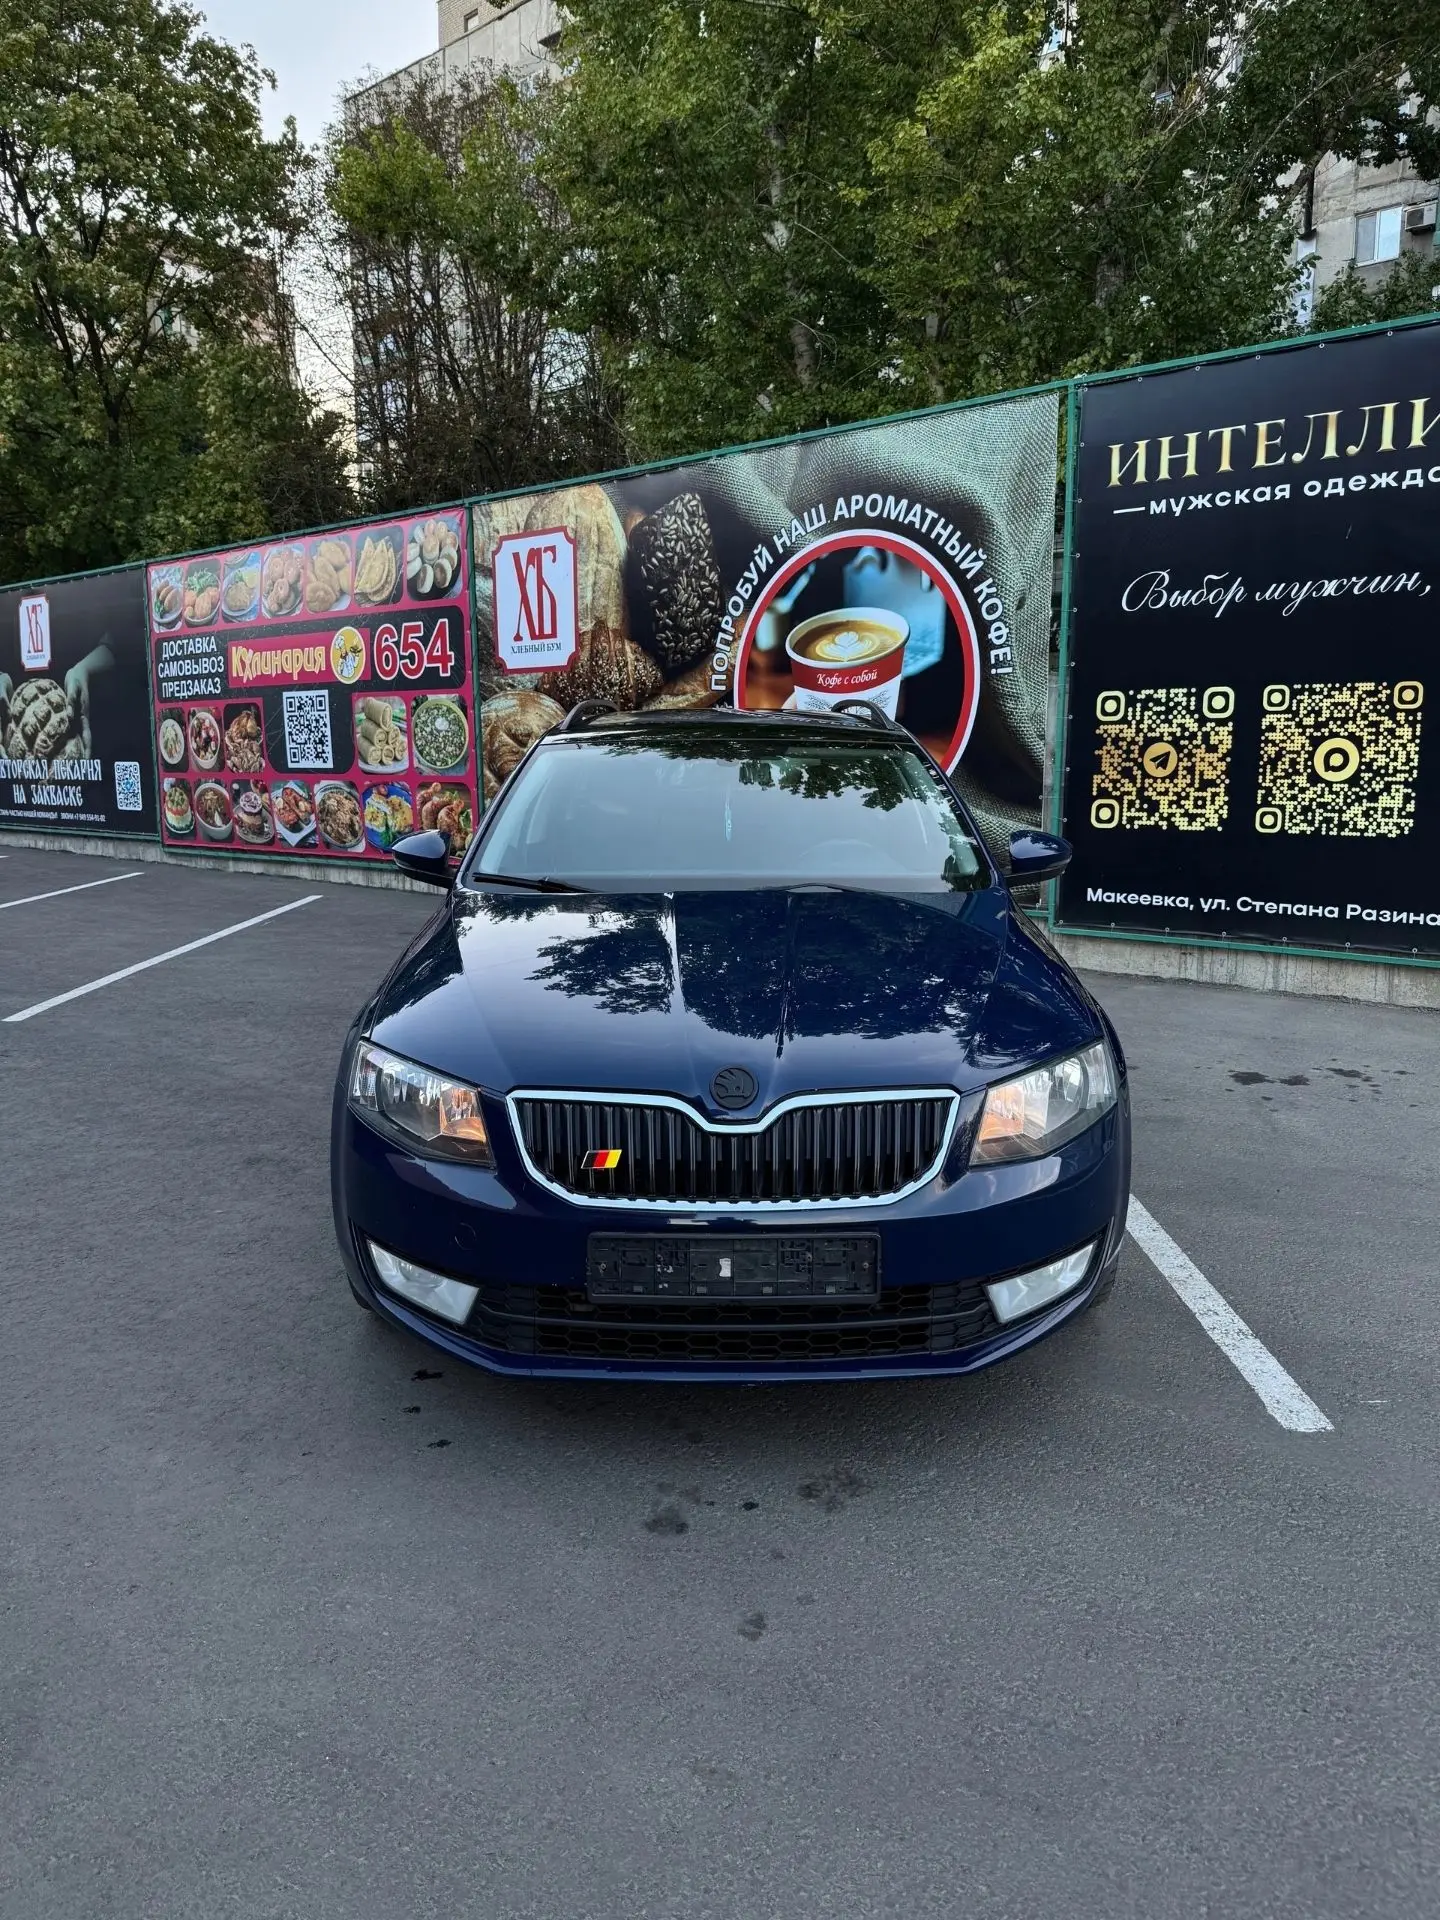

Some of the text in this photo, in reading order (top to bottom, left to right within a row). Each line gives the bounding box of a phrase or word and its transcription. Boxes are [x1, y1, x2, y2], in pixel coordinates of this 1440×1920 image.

[1150, 483, 1291, 517] мужская
[711, 493, 1013, 691] ПОПРОБУЙ НАШ АРОМАТНЫЙ КОФЕ!
[1121, 568, 1432, 618] Выбор мужчин,
[162, 636, 217, 661] ДОСТАВКА
[374, 618, 454, 681] 654
[511, 642, 562, 654] ХЛЕБНЫЙ БУМ
[158, 656, 225, 679] САМОВЫВОЗ
[817, 669, 878, 688] Кофе с собой
[162, 677, 221, 699] ПРЕДЗАКАЗ
[13, 784, 83, 806] НА ЗАКВАСКЕ
[1087, 888, 1440, 926] Макеевка, ул. Степана Разина
